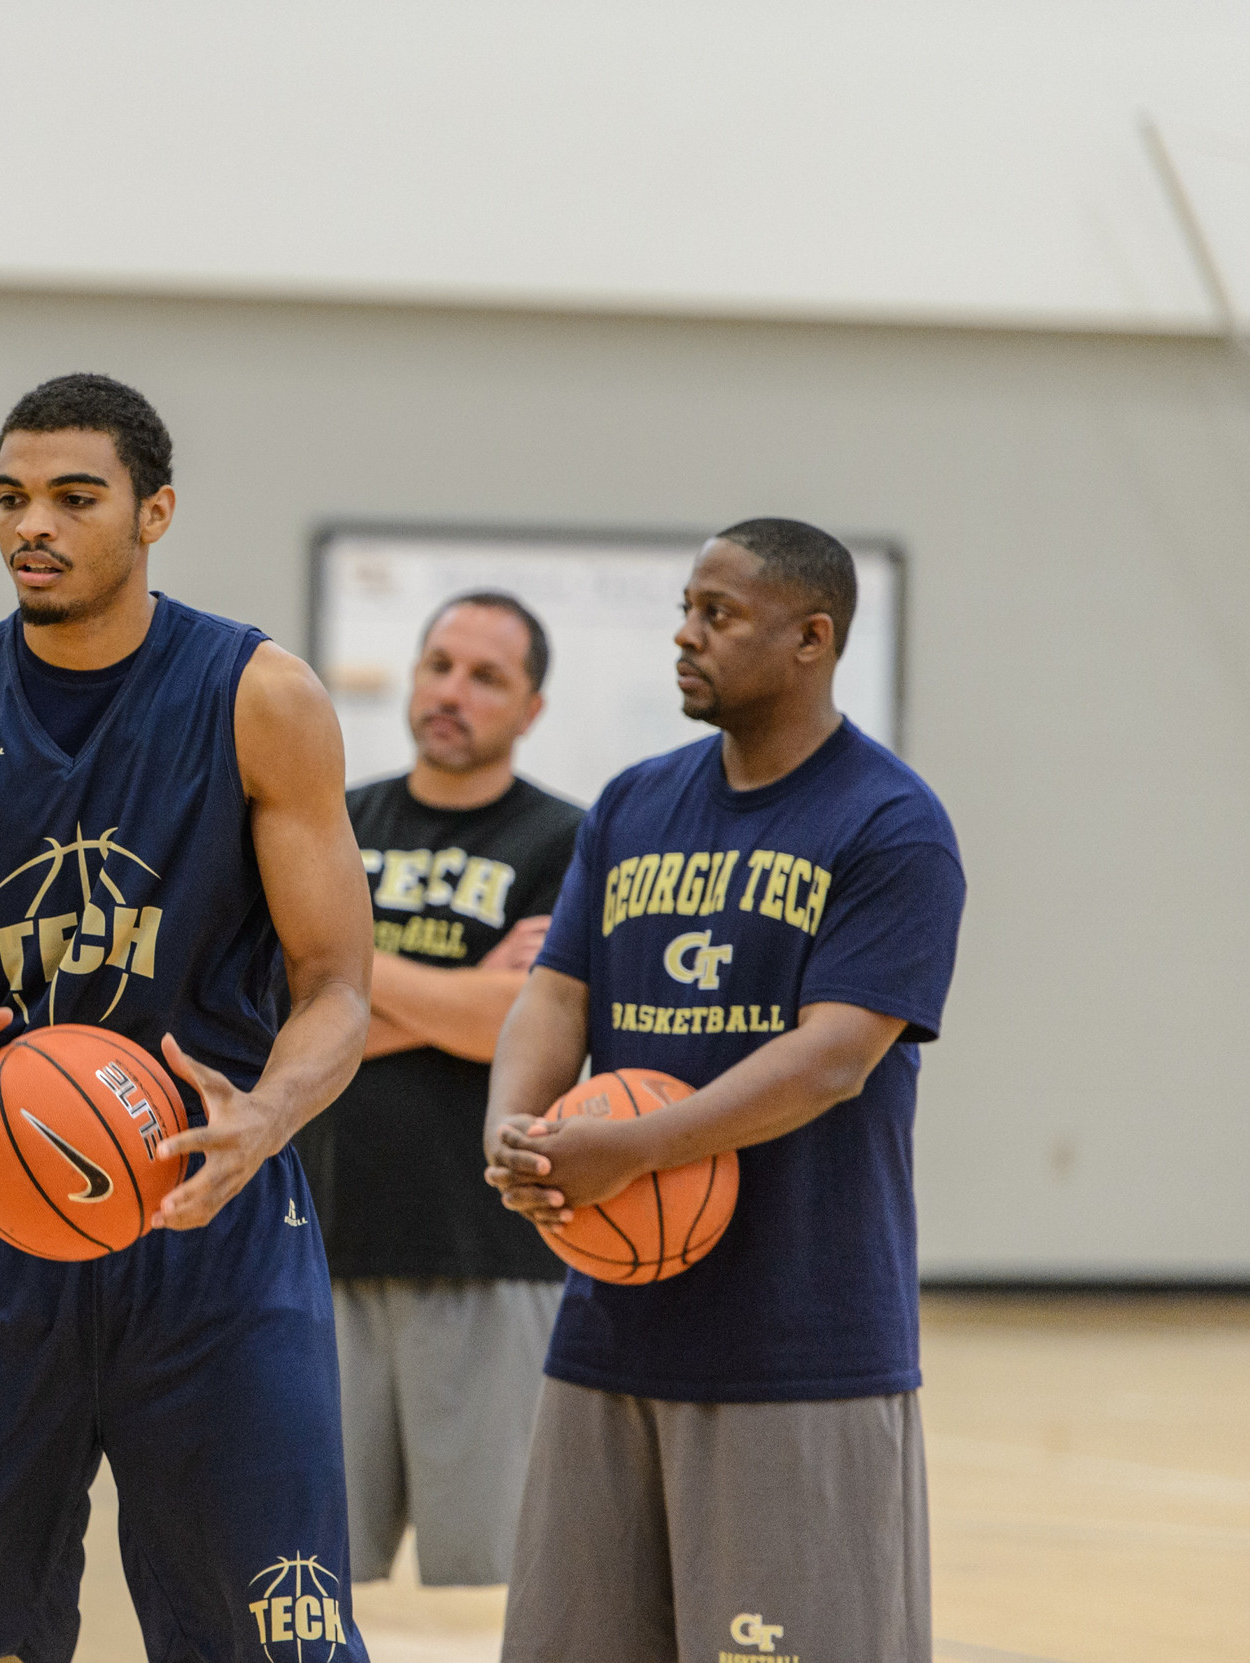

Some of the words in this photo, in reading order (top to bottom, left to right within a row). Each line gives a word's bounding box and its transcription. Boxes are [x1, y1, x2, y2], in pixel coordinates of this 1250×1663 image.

[602, 849, 740, 938] GEORGIA
[739, 849, 832, 937] TECH
[664, 929, 733, 990] GT
[612, 1002, 785, 1035] BASKETBALL
[95, 1061, 163, 1163] ELITE
[248, 1594, 347, 1645] TECH
[730, 1612, 784, 1652] GT
